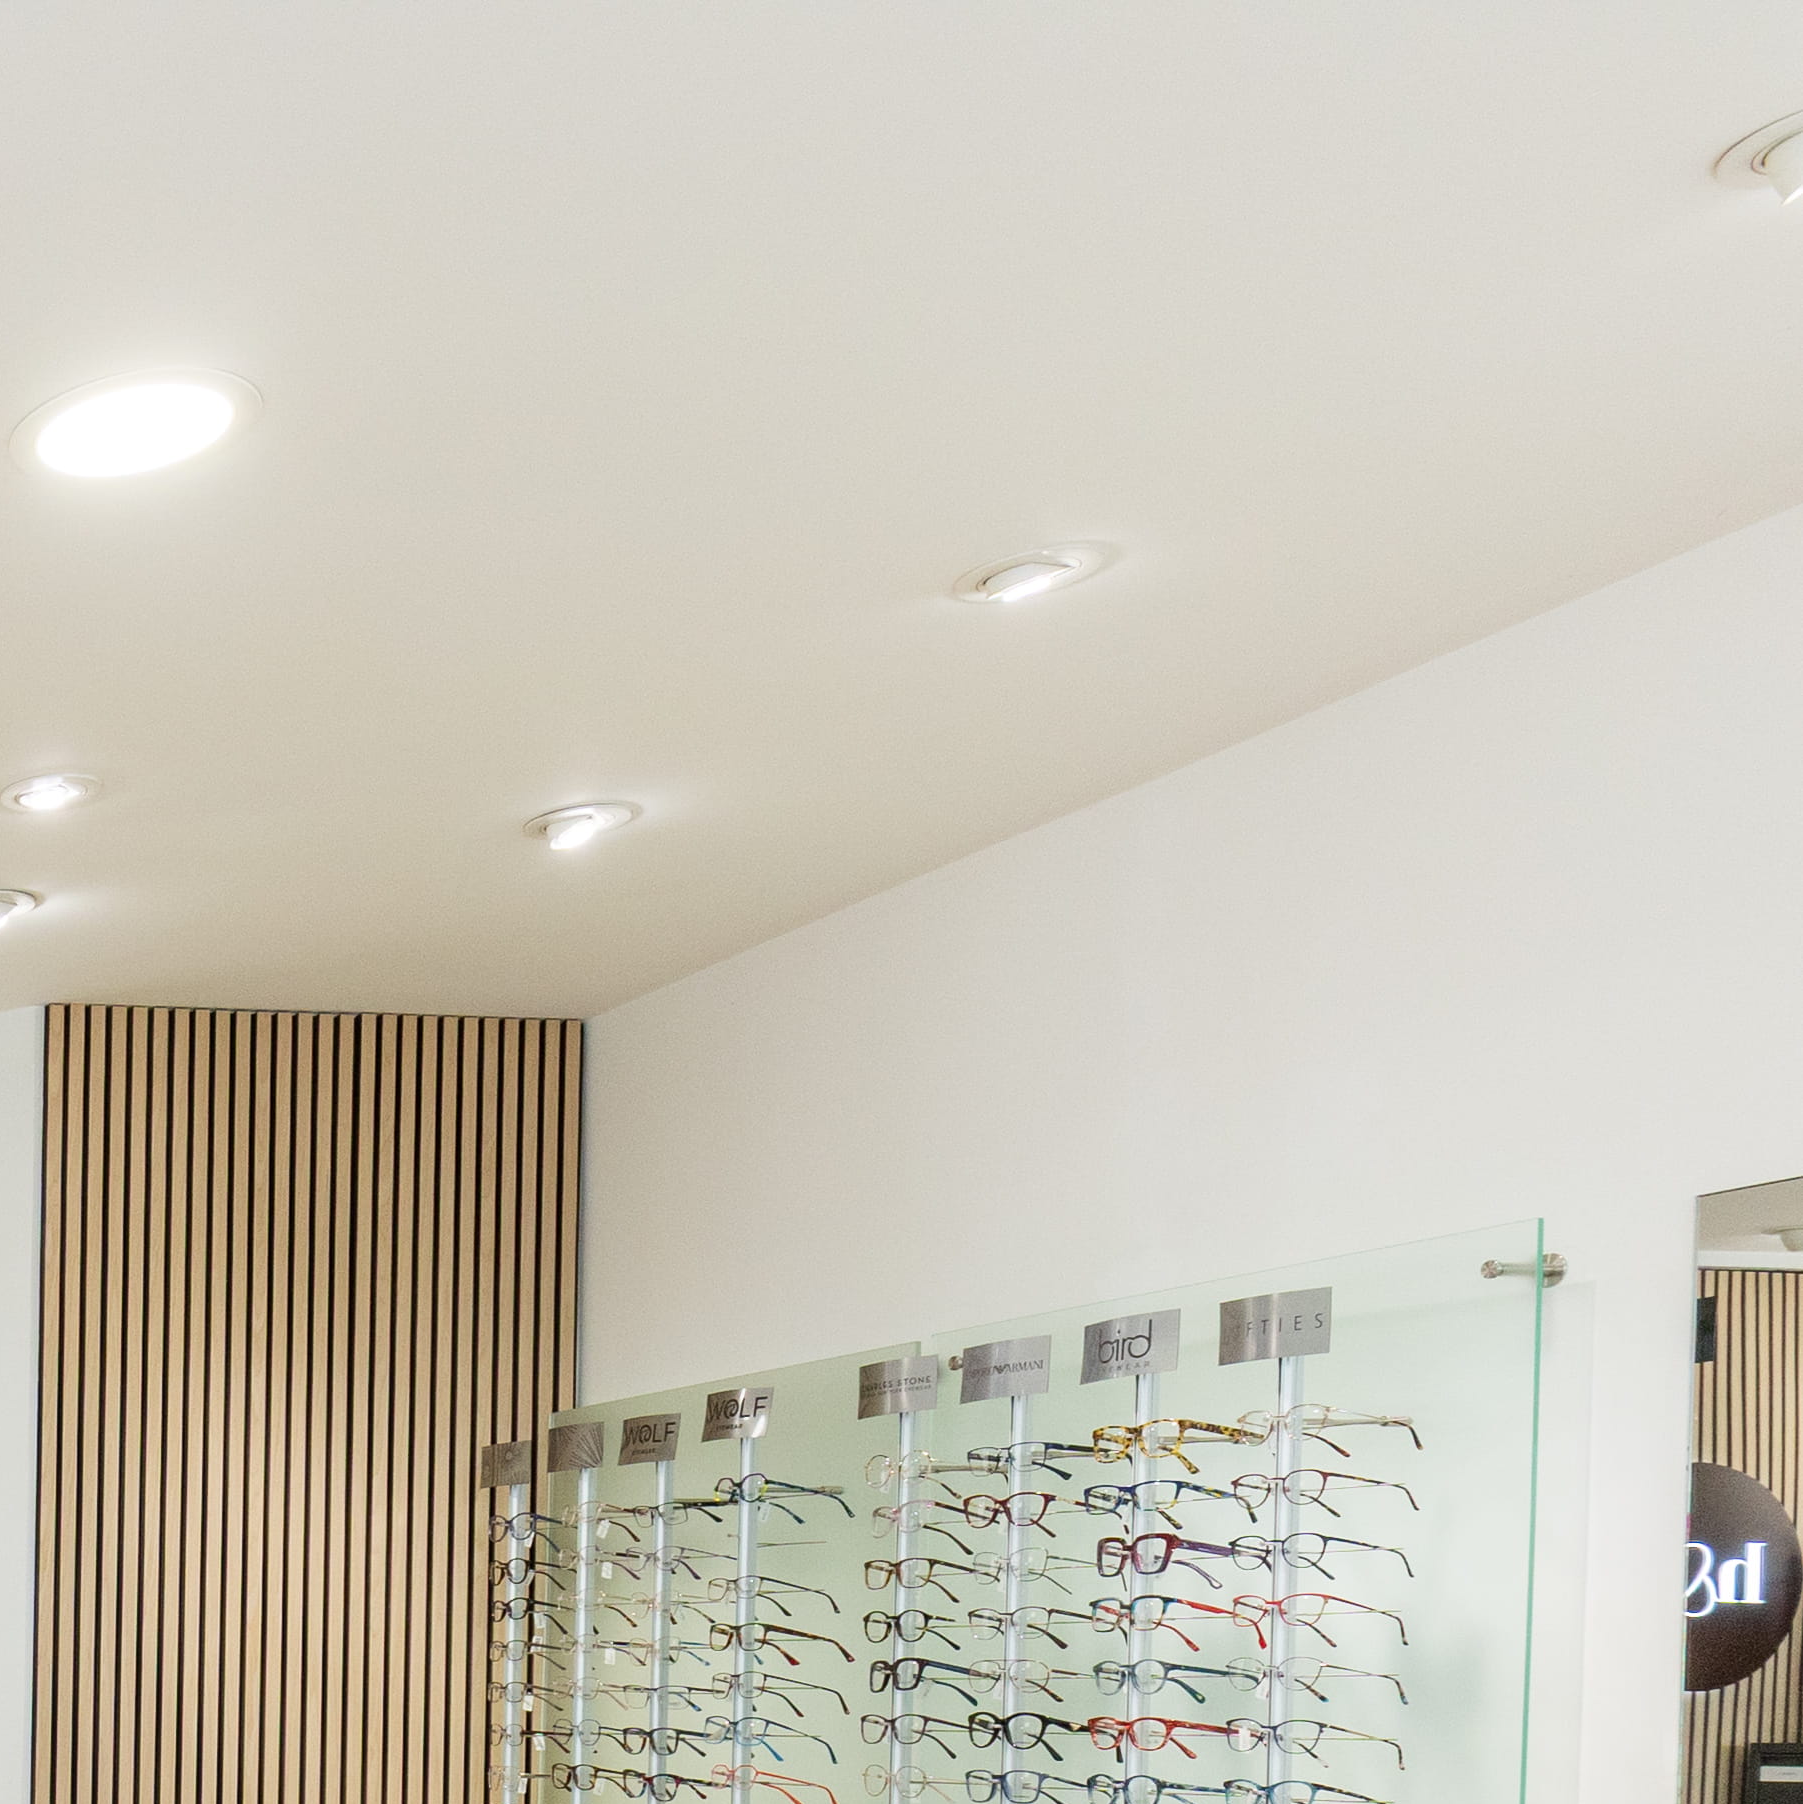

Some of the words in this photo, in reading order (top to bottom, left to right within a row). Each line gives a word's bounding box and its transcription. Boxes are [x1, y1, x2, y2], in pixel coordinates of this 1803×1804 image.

[1098, 1319, 1152, 1364] bird
[1004, 1359, 1044, 1375] ARMANI
[897, 1375, 931, 1387] STONE
[706, 1396, 768, 1422] WOLF
[624, 1422, 676, 1447] WOLF
